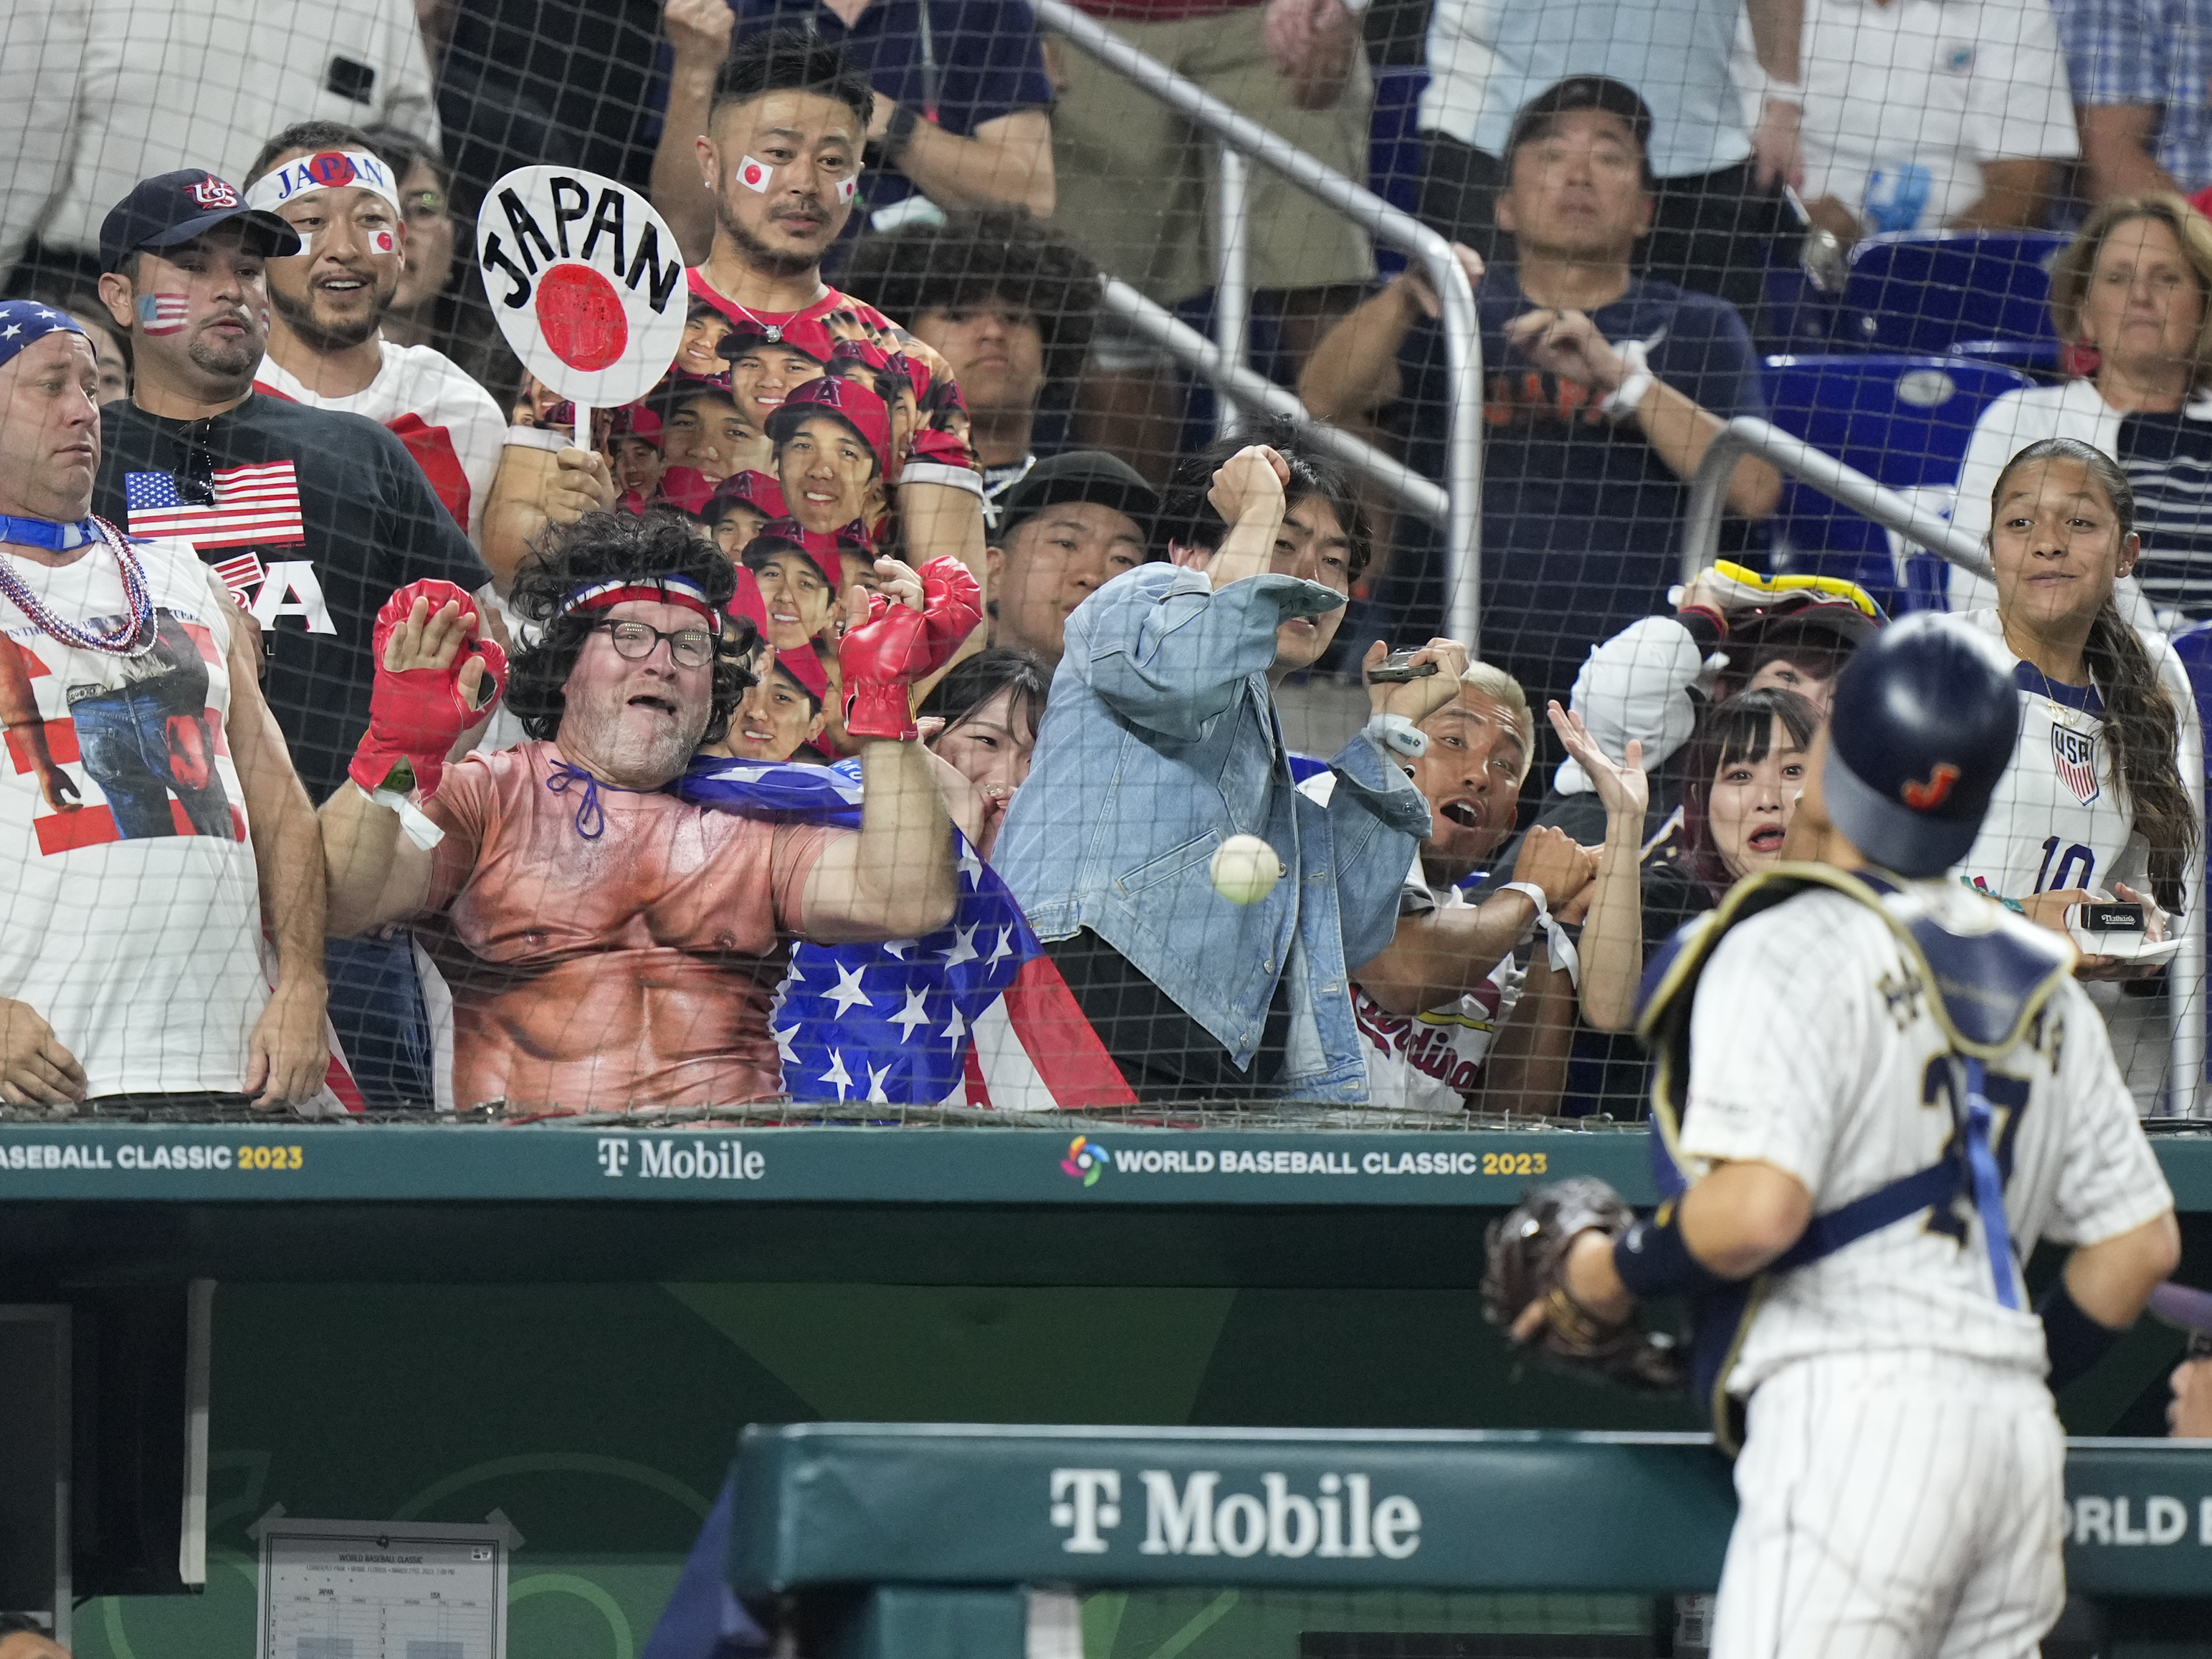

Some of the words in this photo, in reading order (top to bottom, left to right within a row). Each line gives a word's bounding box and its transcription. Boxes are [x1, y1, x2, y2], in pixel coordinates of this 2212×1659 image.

[277, 156, 384, 199] JAPAN
[482, 176, 681, 315] JAPAN
[2055, 730, 2089, 765] USA
[1900, 762, 1962, 811] J
[2033, 835, 2095, 895] 10
[116, 1145, 232, 1170] CLASSIC
[238, 1146, 304, 1170] 2023
[638, 1139, 766, 1180] Mobile
[1115, 1150, 1215, 1173] WORLD
[1219, 1151, 1358, 1174] BASEBALL
[1362, 1152, 1477, 1175] CLASSIC
[1482, 1152, 1548, 1175] 2023
[1138, 1470, 1422, 1559] Mobile
